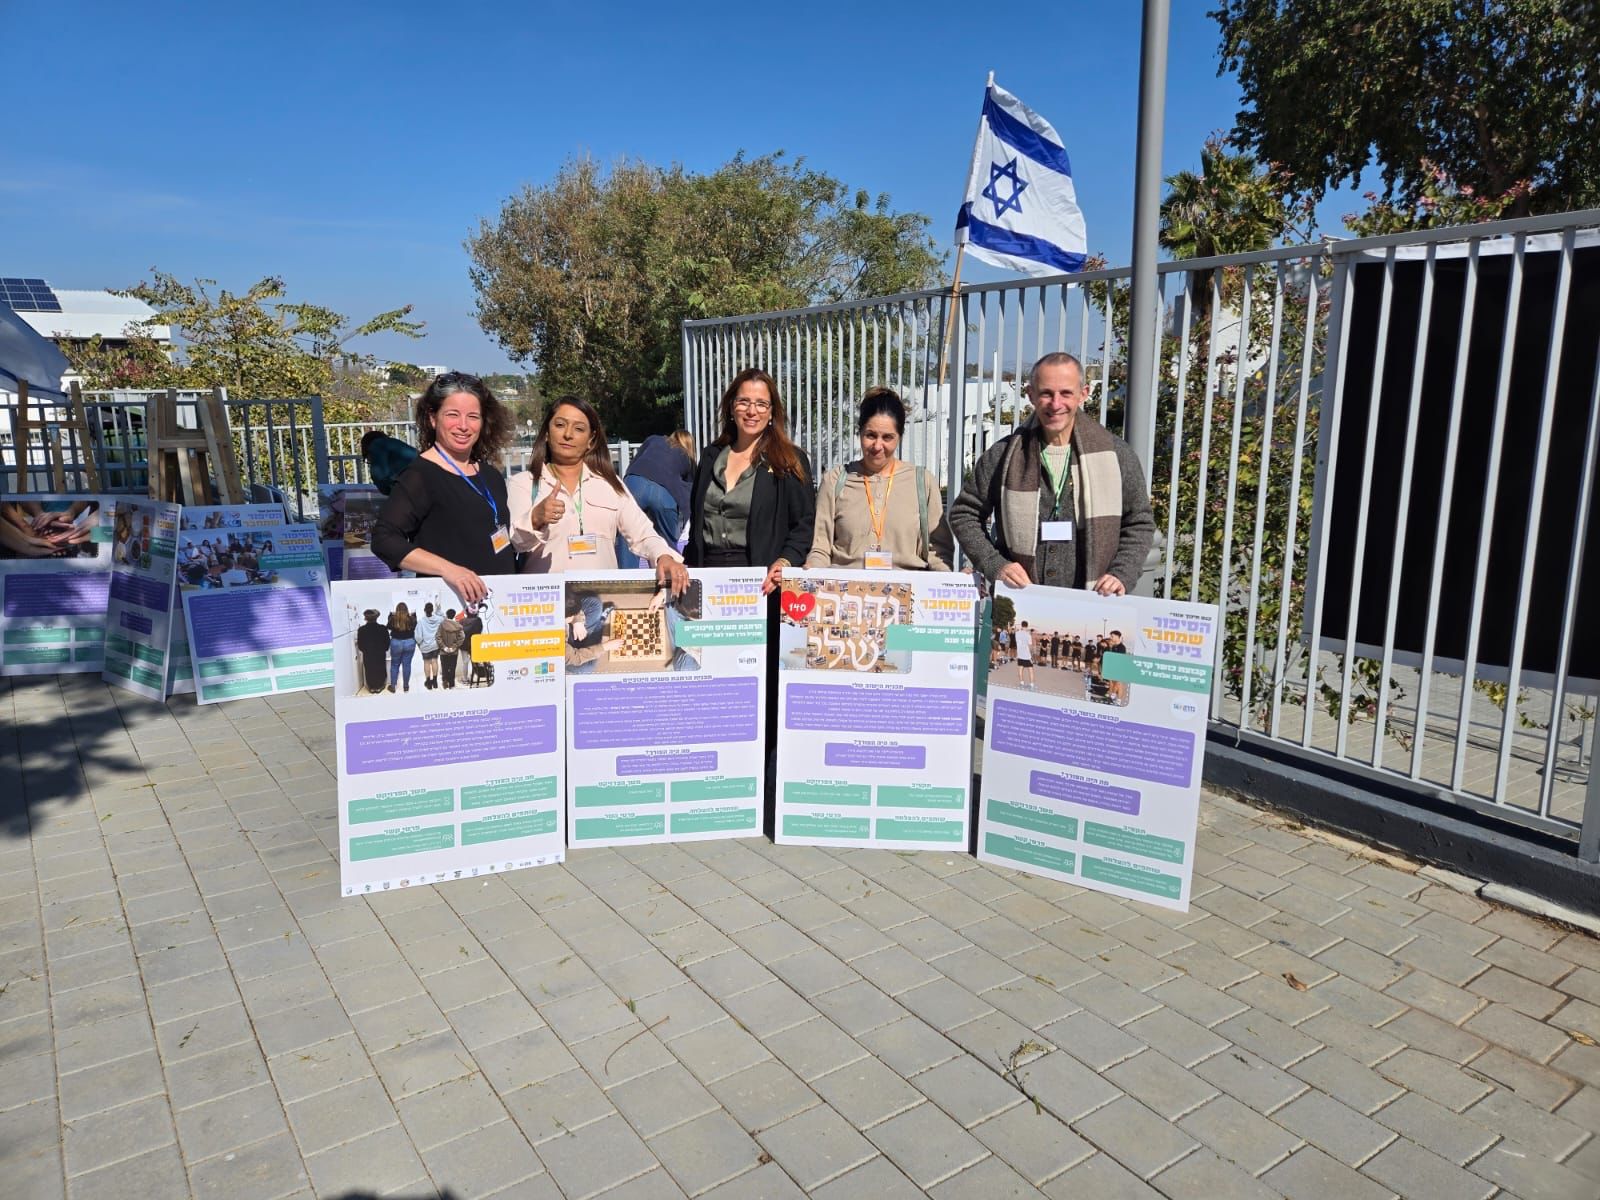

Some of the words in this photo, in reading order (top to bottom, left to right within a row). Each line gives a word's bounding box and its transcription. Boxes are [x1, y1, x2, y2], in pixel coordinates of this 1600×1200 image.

[715, 583, 763, 594] הסיפור
[928, 588, 976, 599] הסיפור
[508, 591, 560, 603] הסיפור
[708, 594, 758, 606] שמחבר
[499, 603, 554, 616] שמחבר
[788, 603, 807, 612] 140
[815, 592, 900, 627] גדרה
[920, 599, 972, 610] שמחבר
[721, 606, 758, 617] בינינו
[933, 611, 970, 622] בינינו
[514, 615, 554, 627] בינינו
[1153, 616, 1211, 634] הסיפור
[1143, 628, 1204, 646] שמחבר
[808, 628, 879, 671] שלי
[1157, 643, 1202, 658] בינינו
[1062, 707, 1077, 715] קרבי
[1078, 710, 1096, 718] כושר
[1097, 713, 1120, 722] קבוצת
